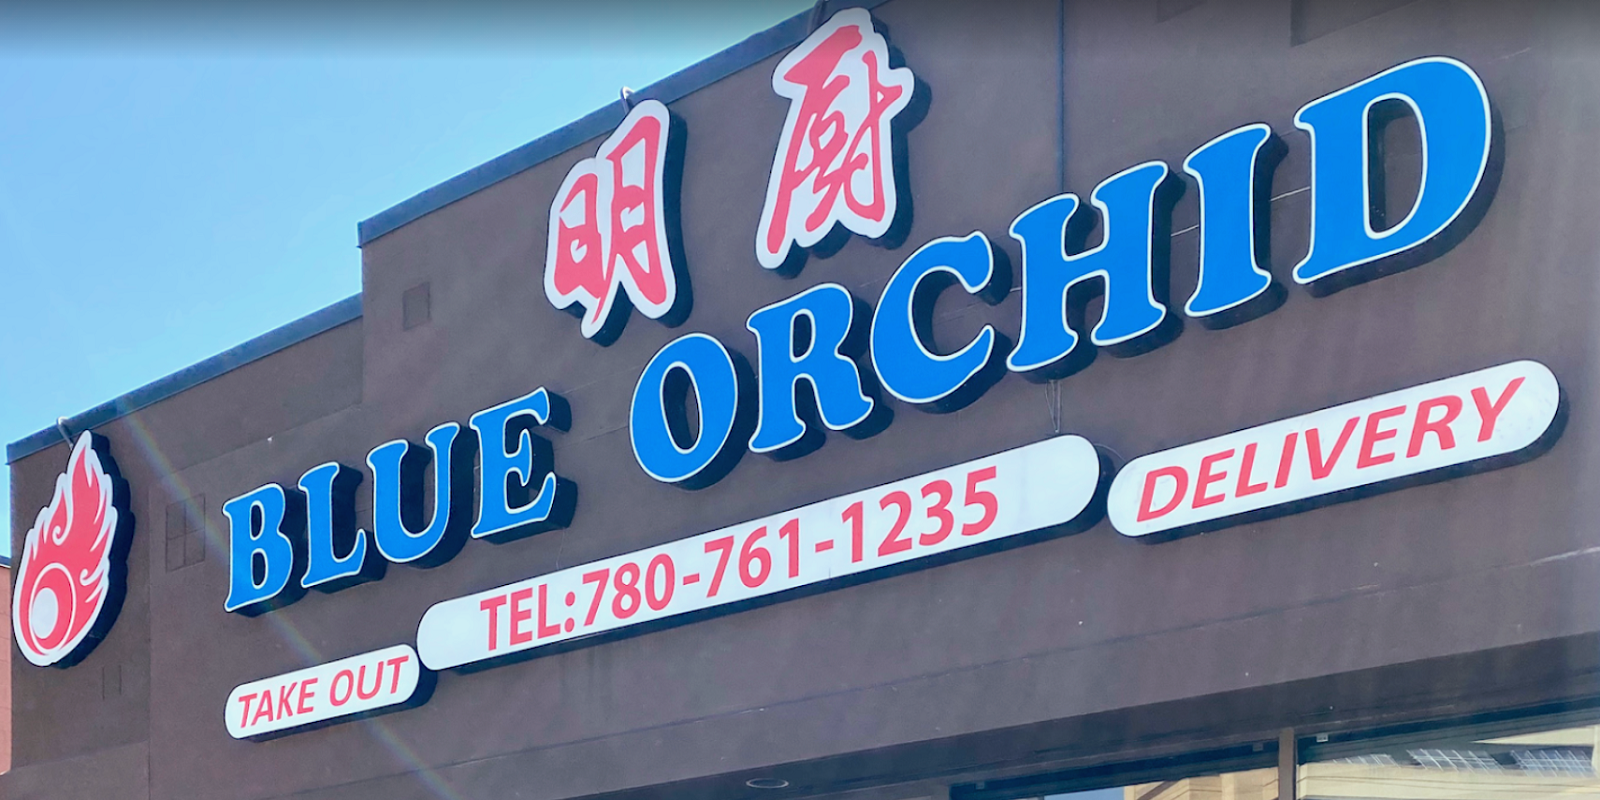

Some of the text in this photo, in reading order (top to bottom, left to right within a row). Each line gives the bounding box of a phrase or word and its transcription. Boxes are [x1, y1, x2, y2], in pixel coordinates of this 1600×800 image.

[222, 56, 1492, 613] BLUE ORCHID
[1136, 376, 1526, 523] DELIVERY
[480, 465, 999, 652] TEL:780-761-1235
[237, 655, 410, 729] TAKE OUT
